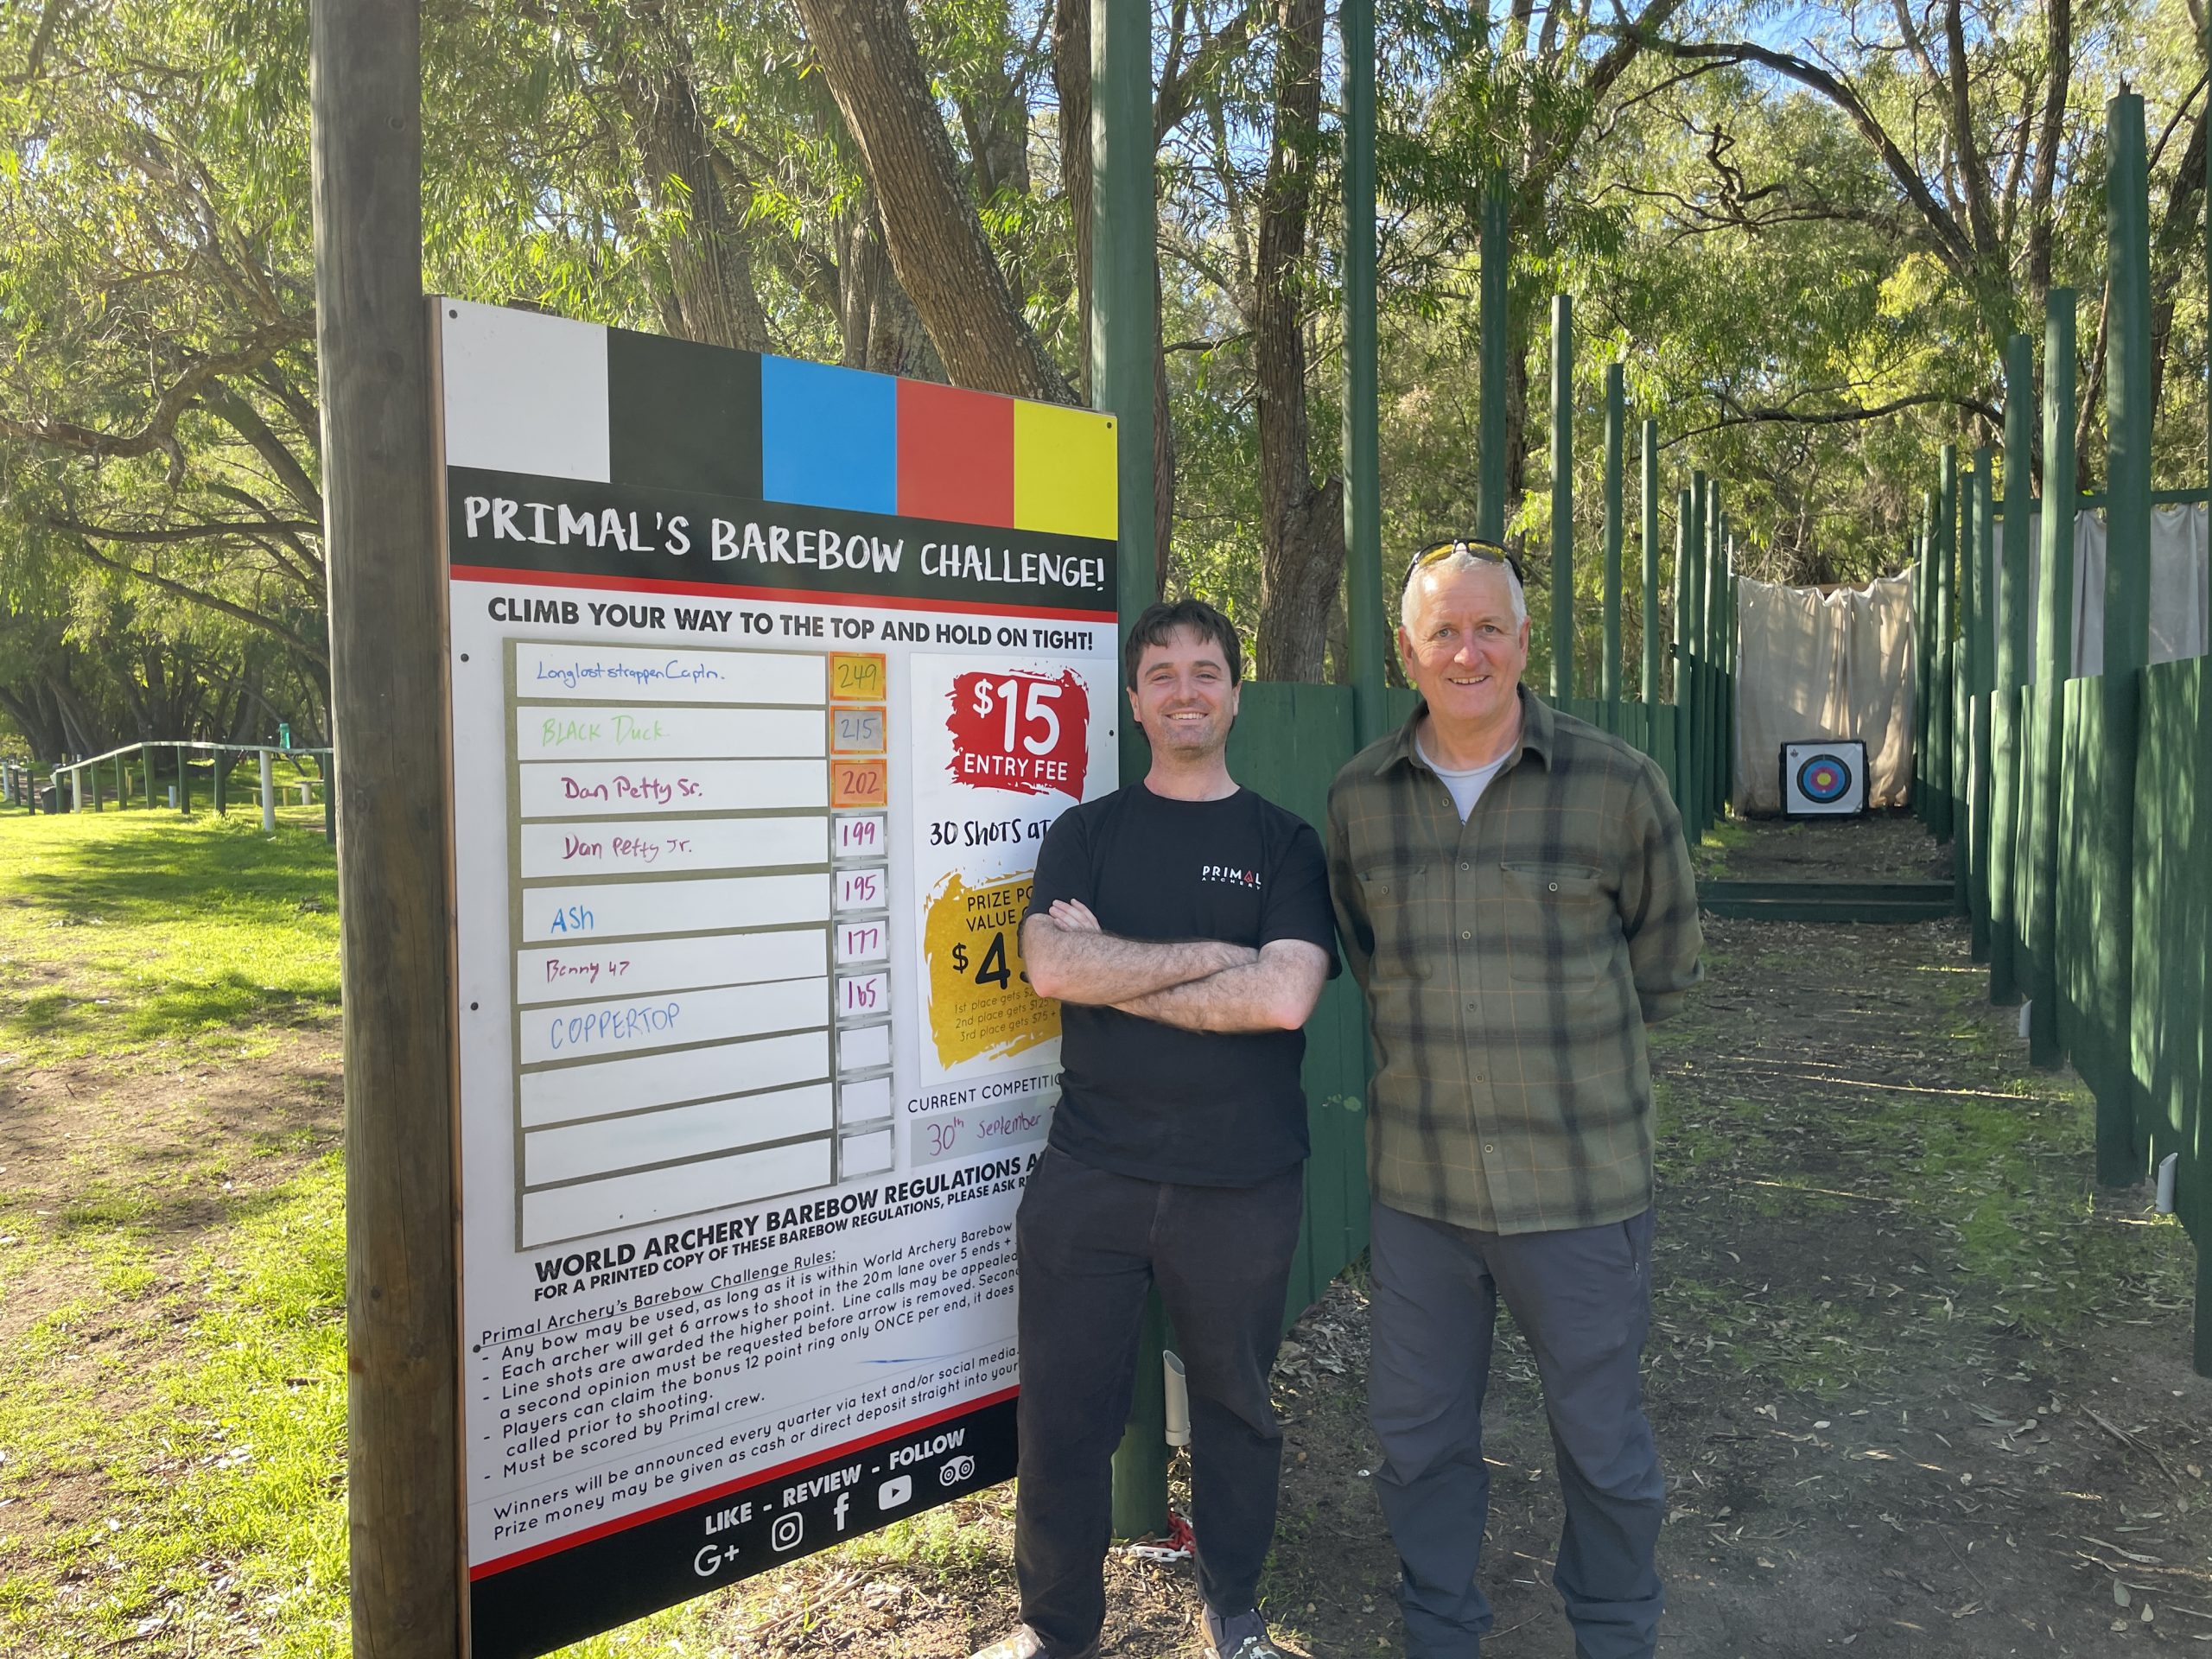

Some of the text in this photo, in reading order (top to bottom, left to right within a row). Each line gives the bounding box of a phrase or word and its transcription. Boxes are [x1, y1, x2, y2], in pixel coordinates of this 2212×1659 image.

[464, 496, 1105, 590] PRIMAL'S BAREBOW CHALLENGE!
[488, 597, 1093, 650] CLIMB YOUR WAY TO THE TOP AND HOLD ON TIGHT!
[839, 664, 877, 691] 249
[841, 717, 877, 742] 215
[973, 677, 1063, 755] $15
[543, 717, 601, 747] BLACK
[964, 753, 1068, 781] ENTRY FEE
[562, 776, 703, 804] Dan Petty Sr.
[842, 770, 878, 795] 202
[562, 832, 602, 859] Dan
[842, 823, 876, 847] 199
[930, 821, 959, 847] 30
[845, 874, 876, 902] 195
[968, 890, 1010, 912] PRIZE
[966, 911, 1016, 932] VALUE
[848, 928, 878, 954] 177
[546, 959, 631, 983] Benny 47
[955, 1004, 966, 1014] 1st
[971, 998, 997, 1011] place
[1001, 990, 1020, 1006] gets
[956, 1014, 973, 1028] 2nd
[978, 1011, 1003, 1023] place
[1007, 1004, 1026, 1018] gets
[551, 1002, 679, 1049] COPPERTOP
[960, 1011, 1047, 1042] 3rd place gets $75
[908, 1089, 976, 1112] CURRENT
[535, 1243, 635, 1282] WORLD
[643, 1215, 759, 1260] ARCHERY
[766, 1189, 878, 1231] BAREBOW
[885, 1157, 1020, 1205] REGULATIONS
[535, 1283, 567, 1301] FOR
[573, 1279, 585, 1293] A
[591, 1262, 658, 1288] PRINTED
[664, 1251, 703, 1271] COPY
[709, 1246, 728, 1261] OF
[732, 1235, 774, 1255] THESE
[779, 1218, 848, 1244] BAREBOW
[852, 1197, 944, 1227] REGULATIONS,
[948, 1185, 988, 1205] PLEASE
[992, 1179, 1014, 1193] ASK
[482, 1319, 541, 1344] Primal
[634, 1283, 703, 1308] Barebow
[711, 1262, 788, 1289] Challenge
[795, 1250, 836, 1268] Rules:
[502, 1223, 1012, 1360] Any bow may be used, as long as it is within World Archery Barebow
[503, 1240, 999, 1379] Each archer will get 6 arrows to shoot in the 20m lane over 5 ends
[504, 1285, 1014, 1438] Players can claim the bonus 12 point ring only ONCE per end, it does
[493, 1348, 1018, 1519] Winners will be announced every quarter via text and/or social media.
[504, 1393, 764, 1478] Must be scored by Primal crew.
[506, 1390, 712, 1456] called prior to shooting.
[706, 1428, 964, 1535] LIKE REVIEW FOLLOW
